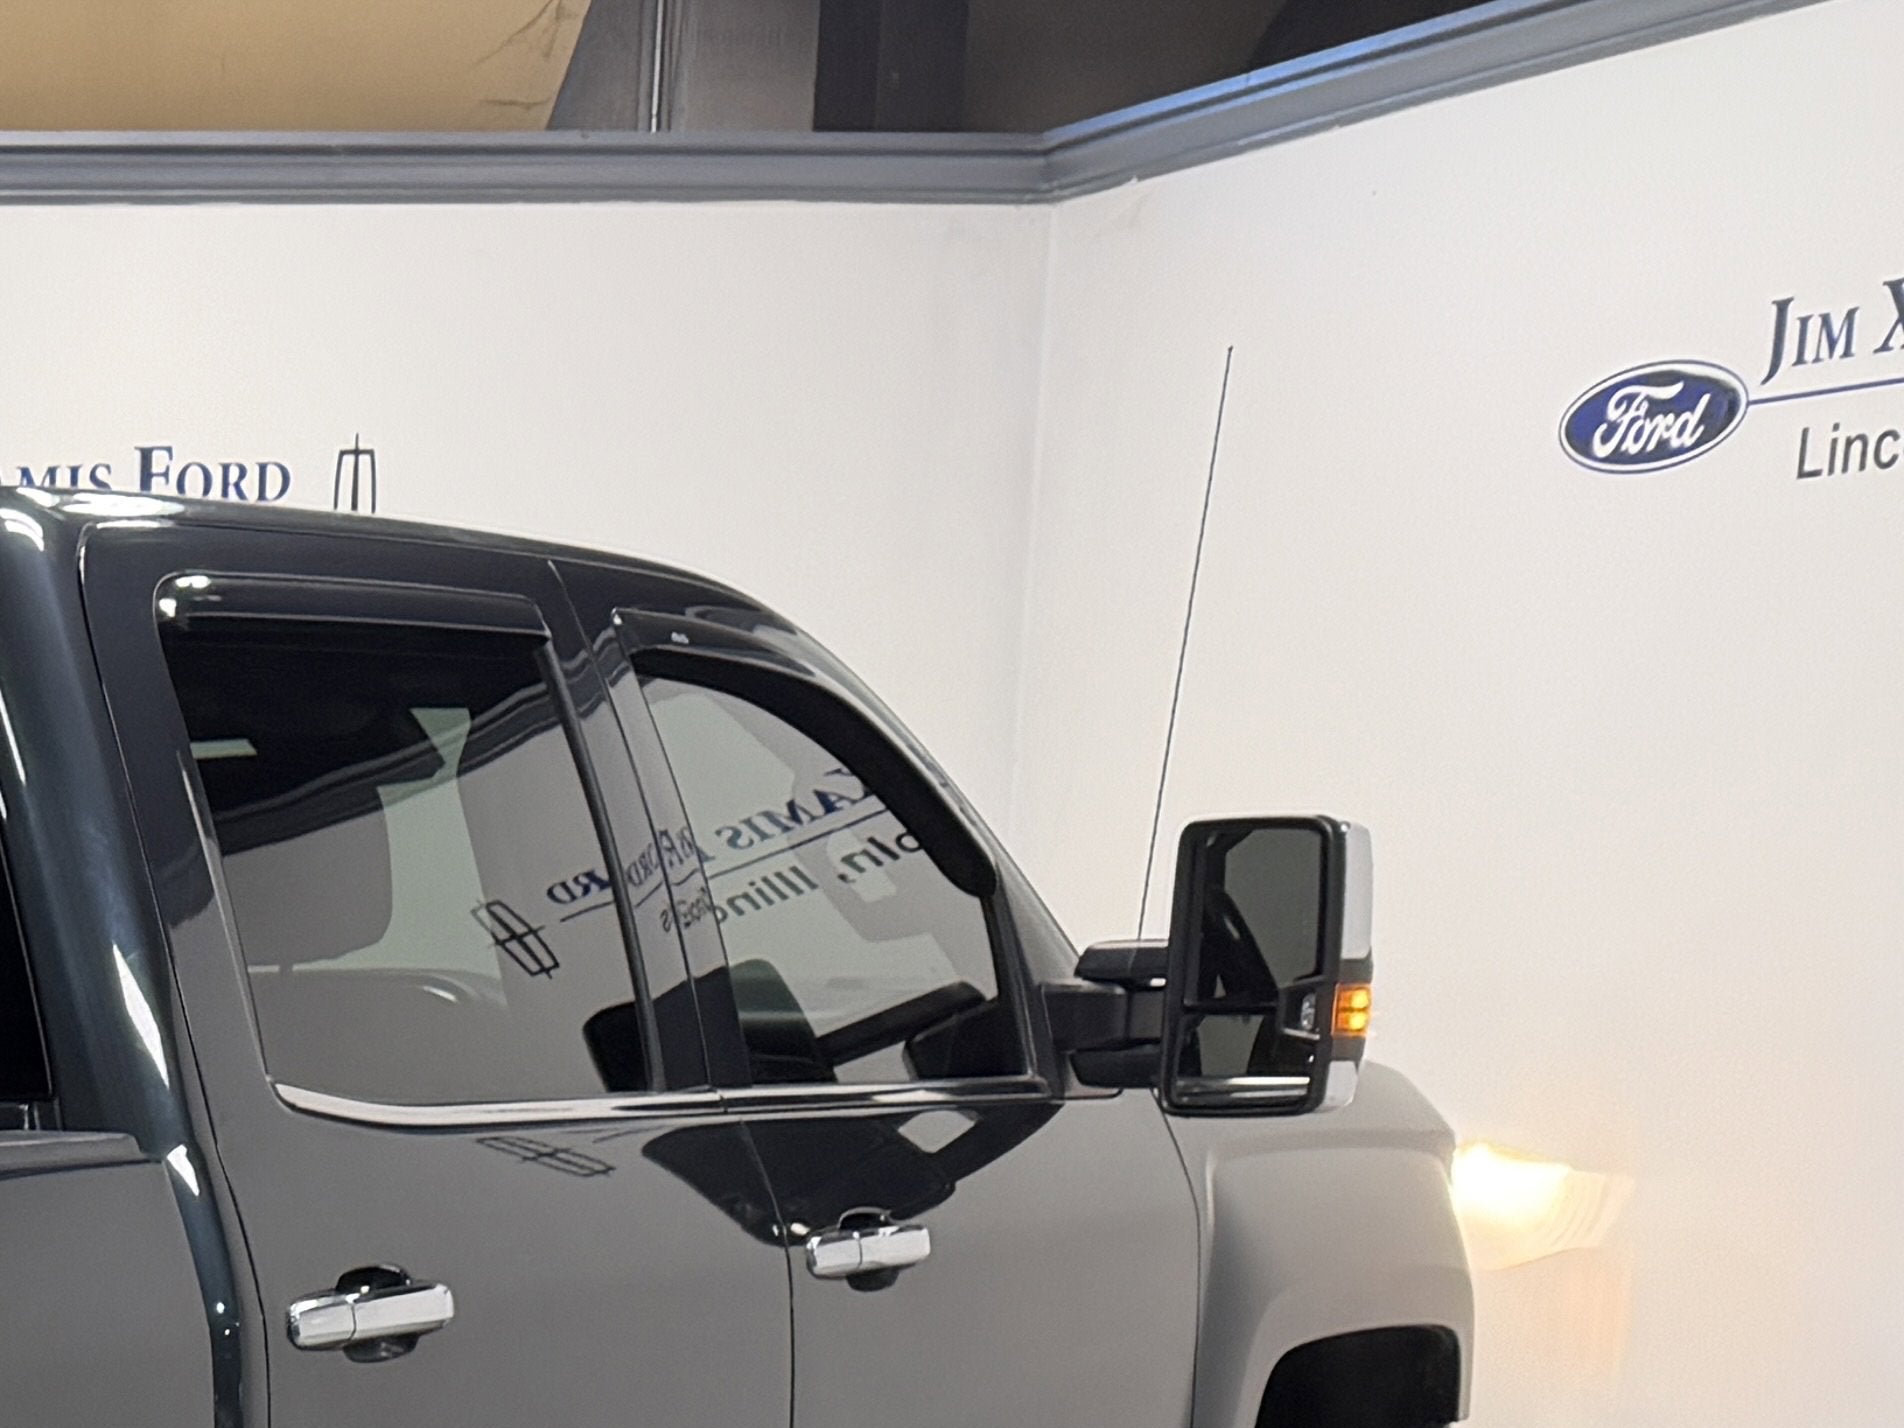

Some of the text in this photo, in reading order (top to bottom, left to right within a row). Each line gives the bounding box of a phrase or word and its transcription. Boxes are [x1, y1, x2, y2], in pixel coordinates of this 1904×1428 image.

[1760, 296, 1859, 386] JIM
[1593, 381, 1712, 459] Ford
[1796, 422, 1904, 480] Linc
[133, 445, 292, 502] FORD
